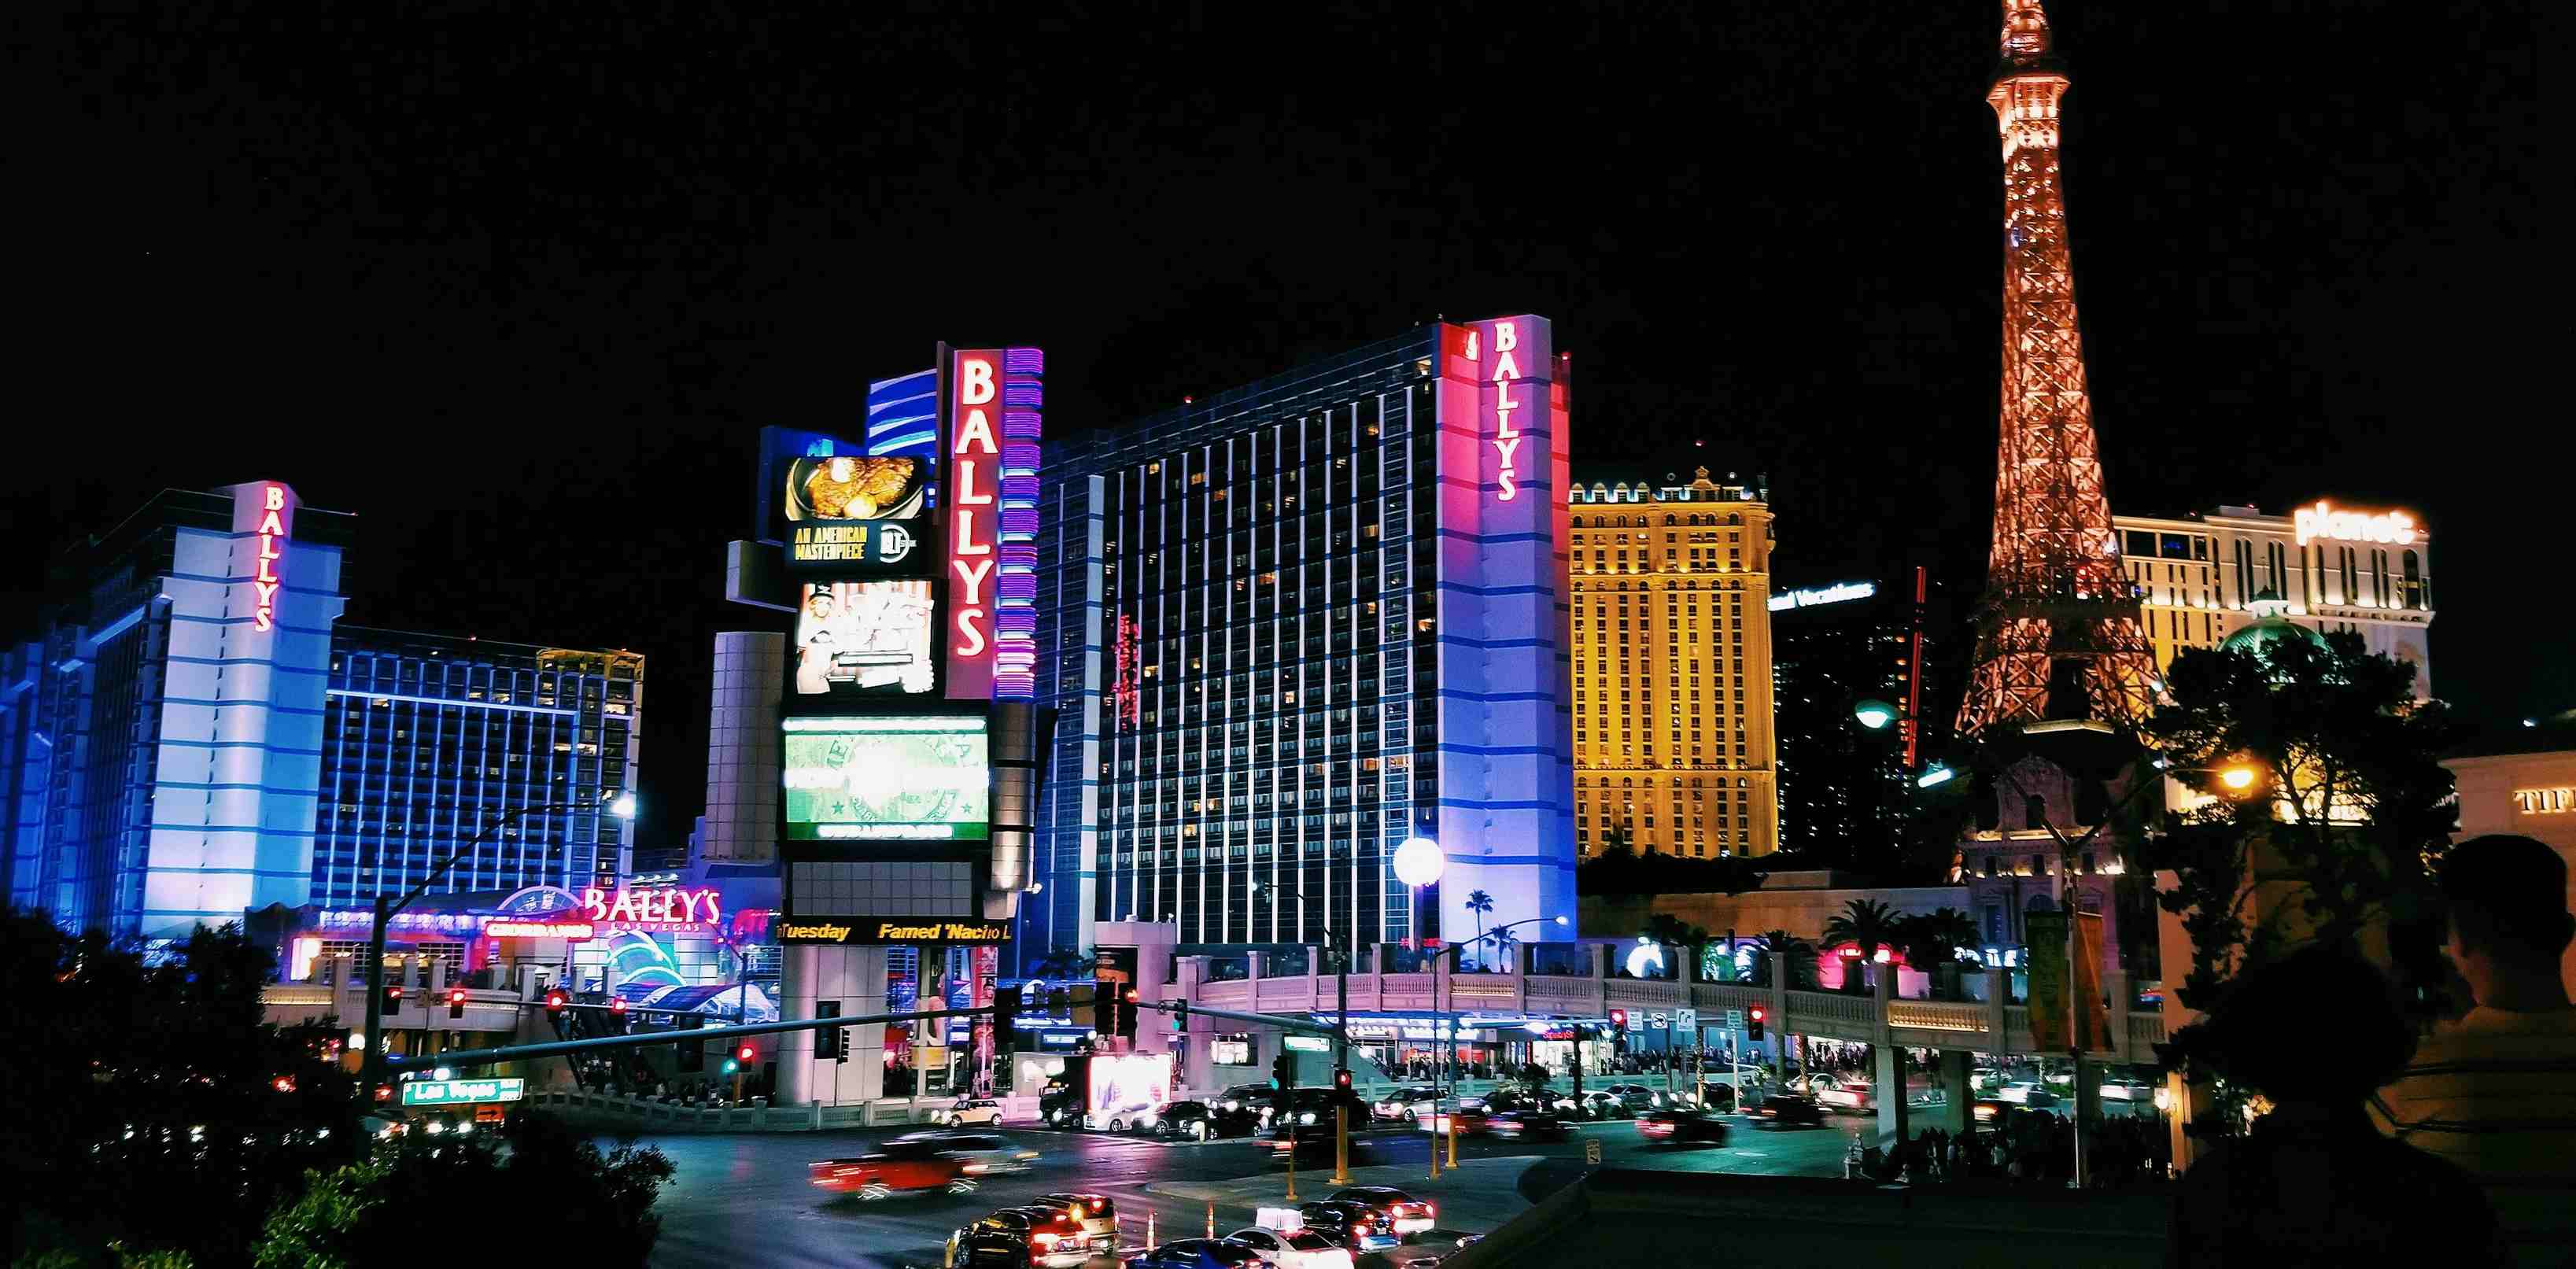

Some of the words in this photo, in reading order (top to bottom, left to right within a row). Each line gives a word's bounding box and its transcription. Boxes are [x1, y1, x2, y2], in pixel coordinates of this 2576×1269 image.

[1492, 322, 1521, 501] BALLYS
[954, 359, 998, 657] BALLYS
[795, 527, 811, 544] AN
[814, 526, 868, 543] AMERICAN
[254, 486, 284, 632] BALLYS
[795, 543, 865, 560] MASTERPIECE
[585, 888, 721, 924] BALLY'S
[611, 921, 643, 931] LAS
[650, 923, 700, 932] VEGAS
[781, 923, 851, 942] Tuesday
[878, 923, 943, 939] Famed
[414, 1083, 445, 1100] Las
[448, 1082, 496, 1101] Vegas
